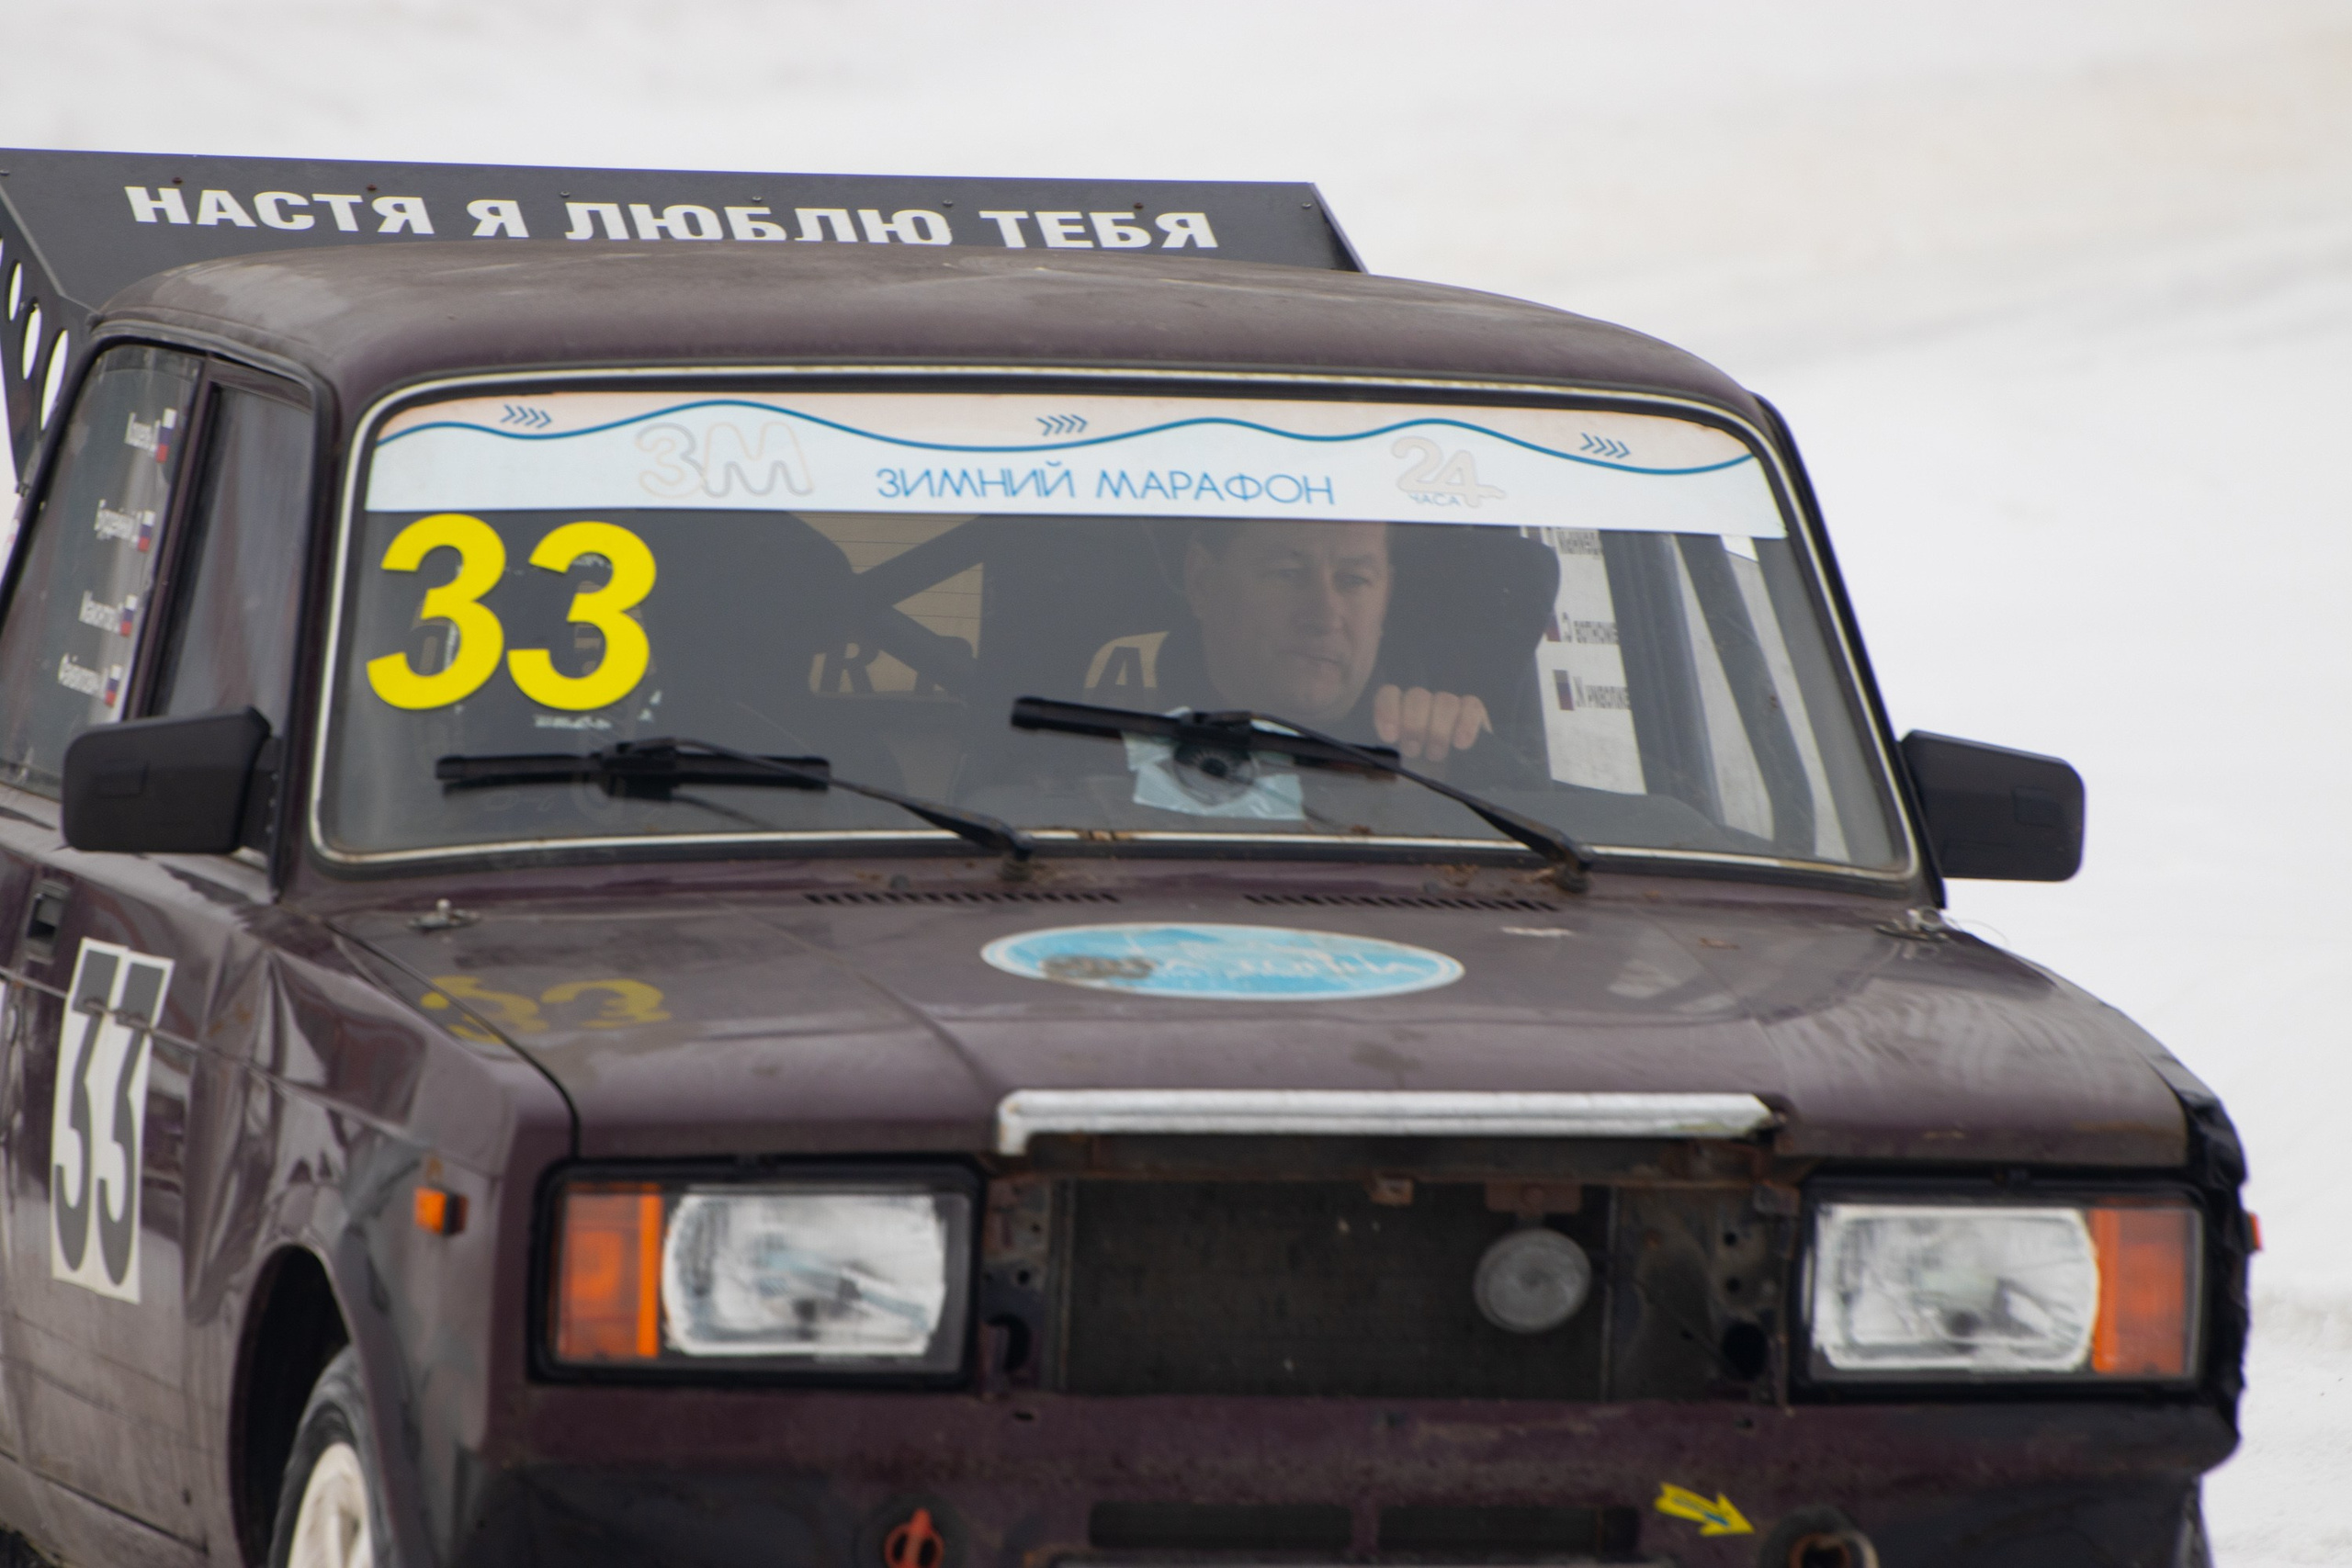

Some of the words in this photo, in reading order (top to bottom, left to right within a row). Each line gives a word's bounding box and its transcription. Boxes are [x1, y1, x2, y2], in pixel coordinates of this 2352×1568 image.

[124, 186, 435, 234] НАСТЯ
[467, 199, 530, 238] Я
[565, 202, 953, 245] ЛЮБЛЮ
[978, 210, 1218, 249] ТЕБЯ
[875, 460, 1076, 500] ЗИМНИЙ
[1095, 468, 1335, 505] МАРАФОН
[1391, 435, 1507, 508] 24
[367, 513, 657, 710] 33
[54, 947, 166, 1287] 33
